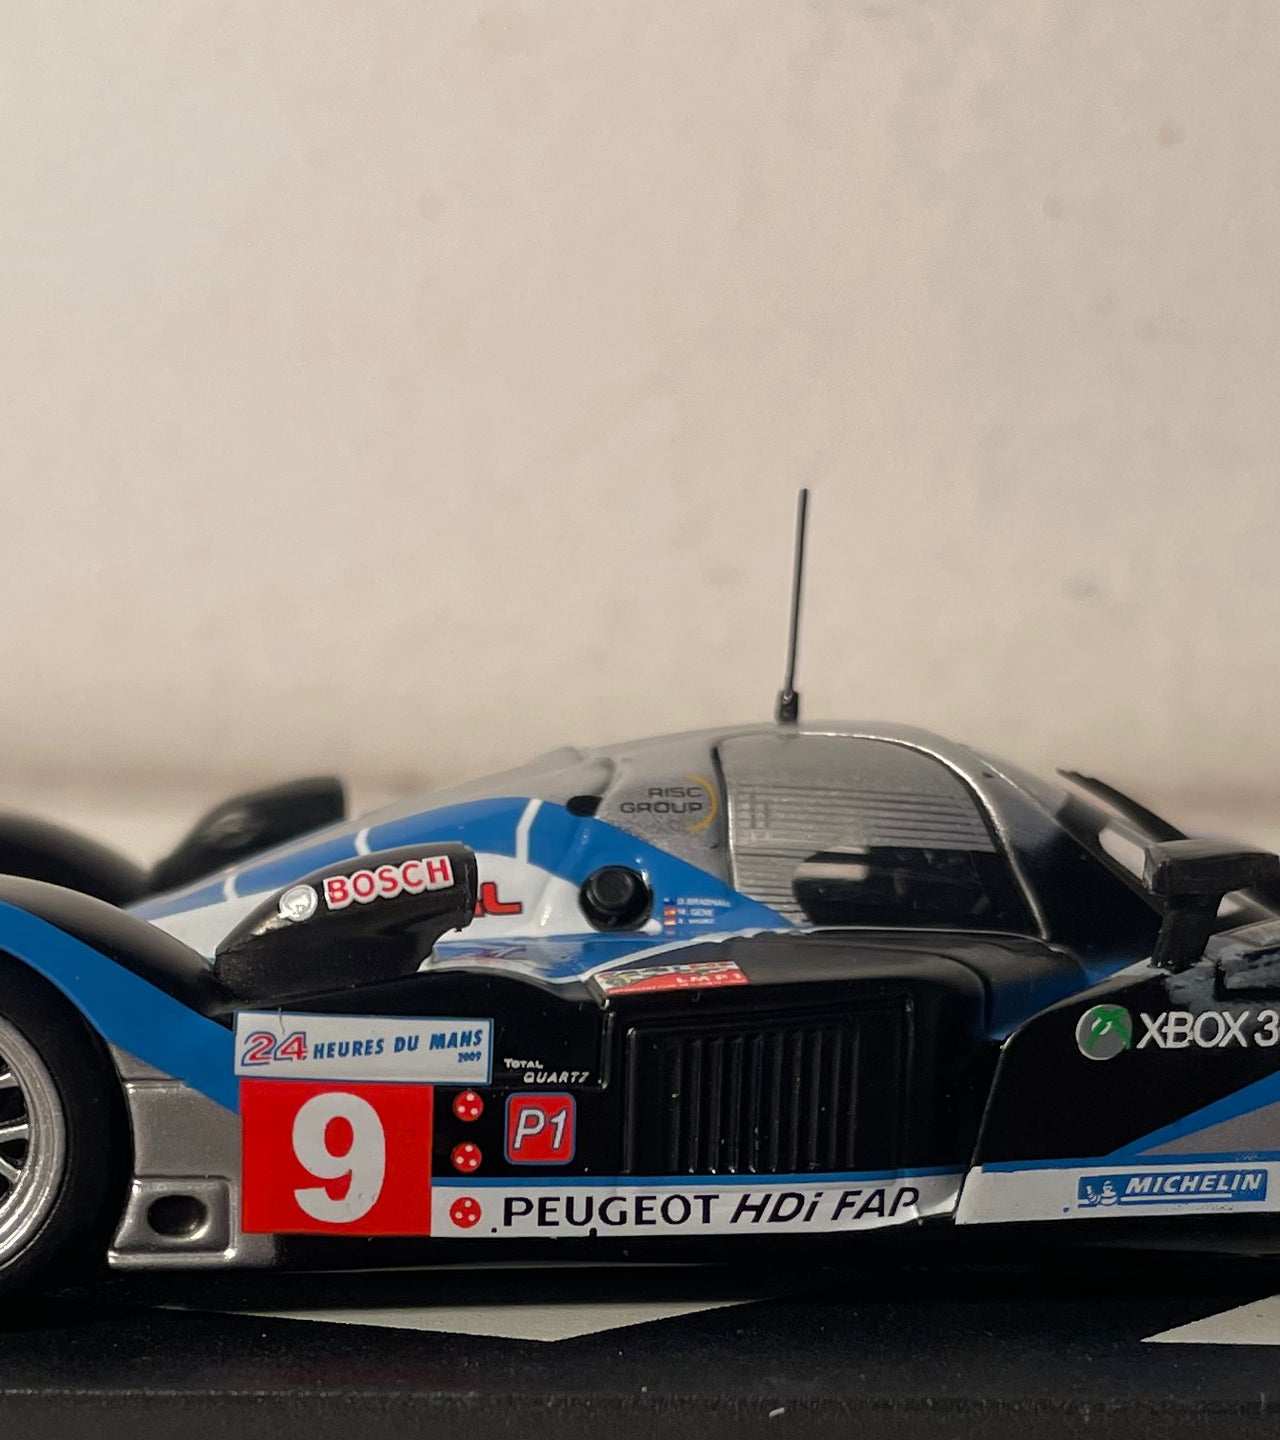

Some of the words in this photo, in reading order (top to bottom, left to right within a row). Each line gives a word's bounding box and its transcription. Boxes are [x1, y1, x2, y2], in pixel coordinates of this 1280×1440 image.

[620, 802, 702, 813] GROUP
[648, 787, 702, 798] RISC
[327, 858, 451, 904] BOSCH
[241, 1031, 309, 1066] 24
[313, 1038, 384, 1060] HEURES
[394, 1035, 419, 1053] DU
[429, 1029, 483, 1050] MANS
[1136, 1011, 1250, 1049] XBOX
[458, 1051, 482, 1064] 2009
[503, 1058, 544, 1069] TOTAL
[512, 1108, 568, 1150] P1
[292, 1092, 386, 1224] 9
[1125, 1173, 1263, 1195] MICHELIN
[503, 1195, 719, 1228] PEUGEOT
[729, 1191, 823, 1224] HDi
[831, 1187, 920, 1221] FAP
